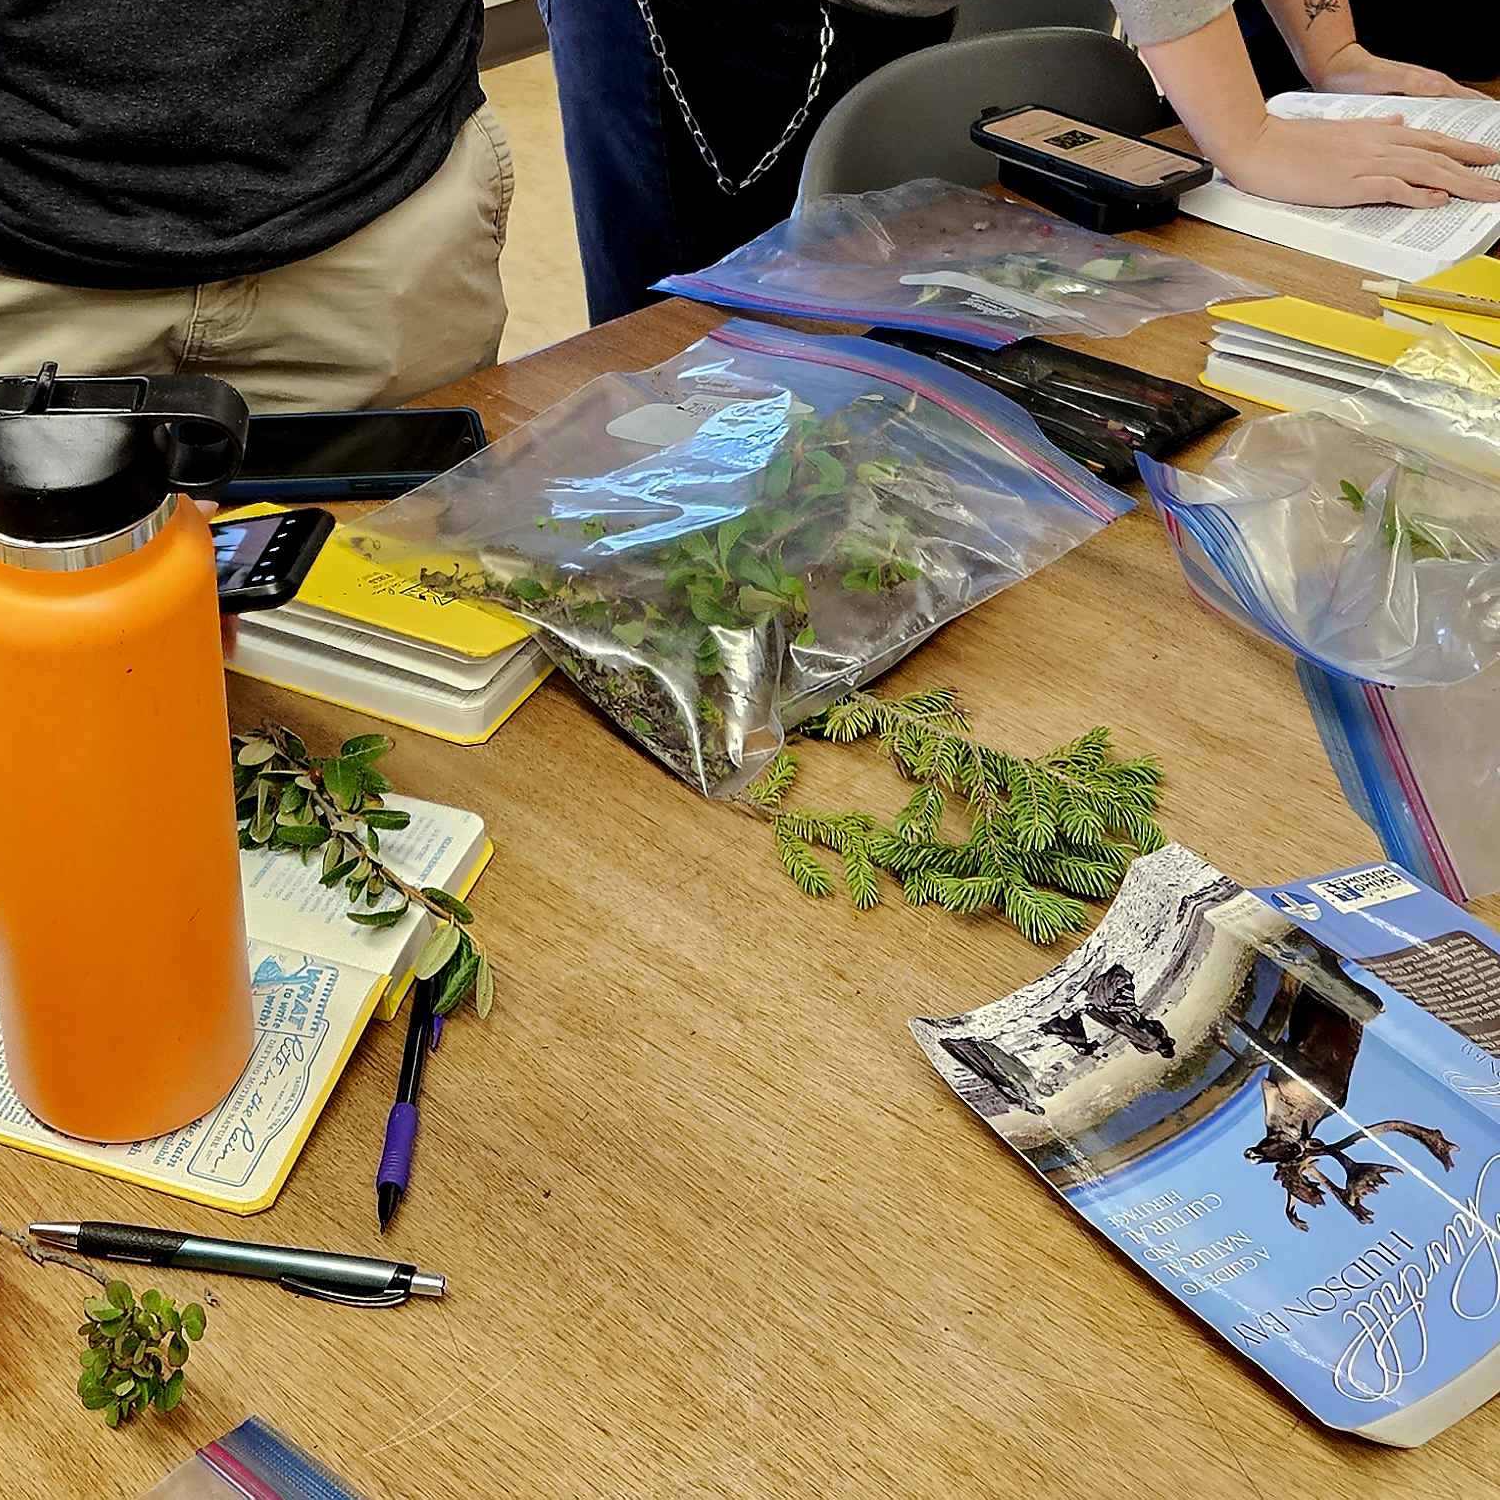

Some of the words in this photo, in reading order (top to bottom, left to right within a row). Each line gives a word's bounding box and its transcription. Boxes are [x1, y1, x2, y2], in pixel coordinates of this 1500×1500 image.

[688, 402, 717, 417] Ziplo
[1345, 866, 1391, 885] MUSEUM
[1353, 873, 1402, 892] ESKIMO
[283, 988, 294, 999] to
[291, 968, 323, 1030] WHAT
[257, 994, 276, 1027] with?
[272, 1001, 289, 1029] write
[257, 1039, 277, 1077] DEFYING
[276, 1034, 304, 1075] Rite
[259, 1066, 278, 1088] in
[236, 1077, 257, 1112] MOTHER
[246, 1089, 264, 1117] the
[211, 1112, 236, 1148] NATURE
[214, 1117, 255, 1169] Rain
[167, 1137, 192, 1168] Rain
[1105, 1189, 1184, 1230] HERITAGE
[1120, 1192, 1223, 1246] CULTURAL
[1142, 1238, 1181, 1263] AND
[1158, 1229, 1254, 1279] NATURAL
[1254, 1246, 1272, 1261] A
[1180, 1276, 1210, 1297] TO
[1203, 1256, 1259, 1287] GUIDE
[1282, 1230, 1415, 1326] HUDSON
[1333, 1152, 1500, 1403] hurchill
[1232, 1311, 1290, 1349] BAY
